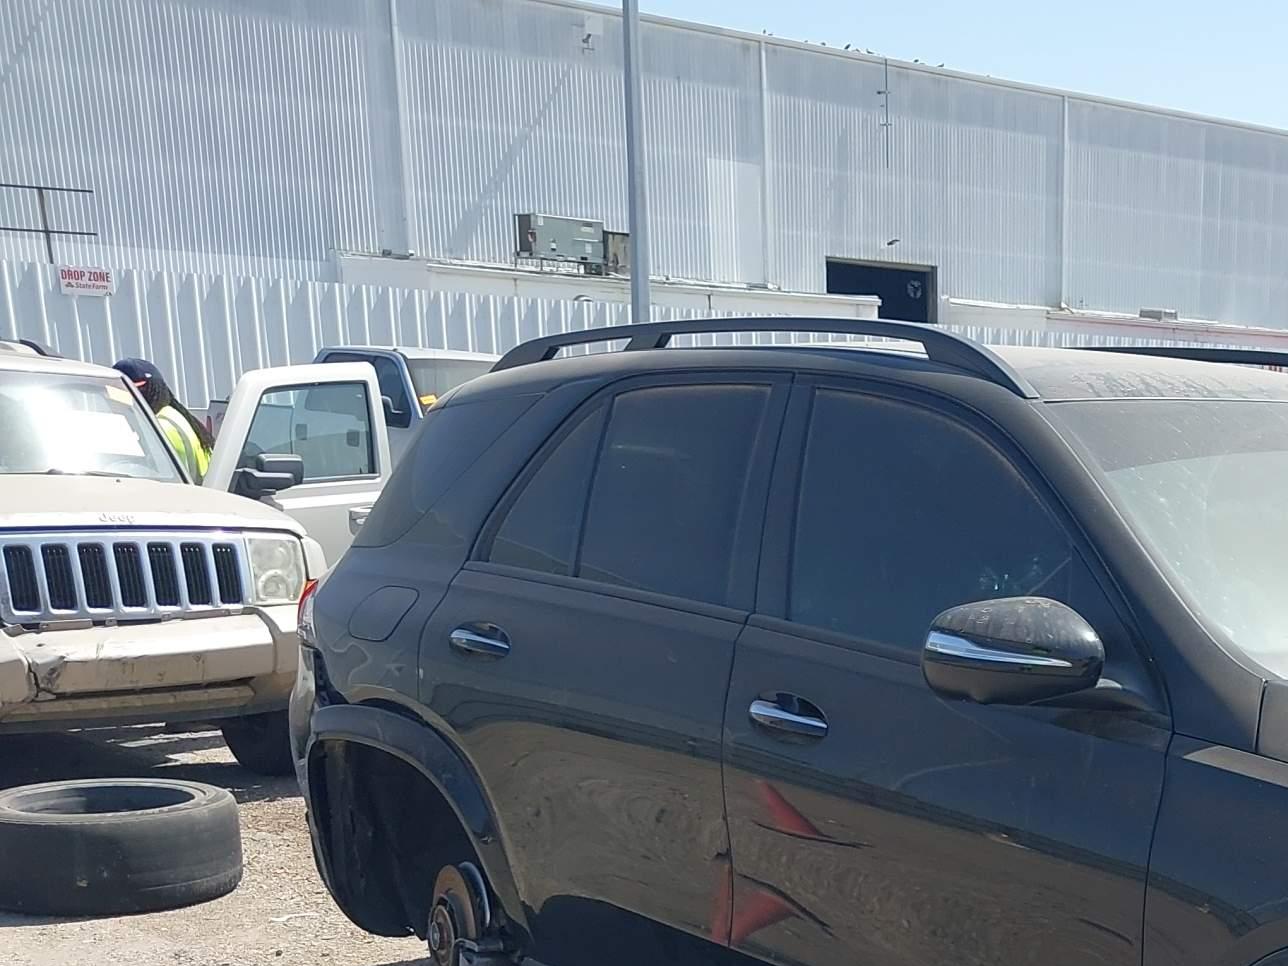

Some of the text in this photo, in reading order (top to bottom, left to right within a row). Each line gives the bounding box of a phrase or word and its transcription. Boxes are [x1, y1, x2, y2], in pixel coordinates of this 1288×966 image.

[61, 269, 111, 283] DROP ZONE
[98, 511, 136, 525] Jeep
